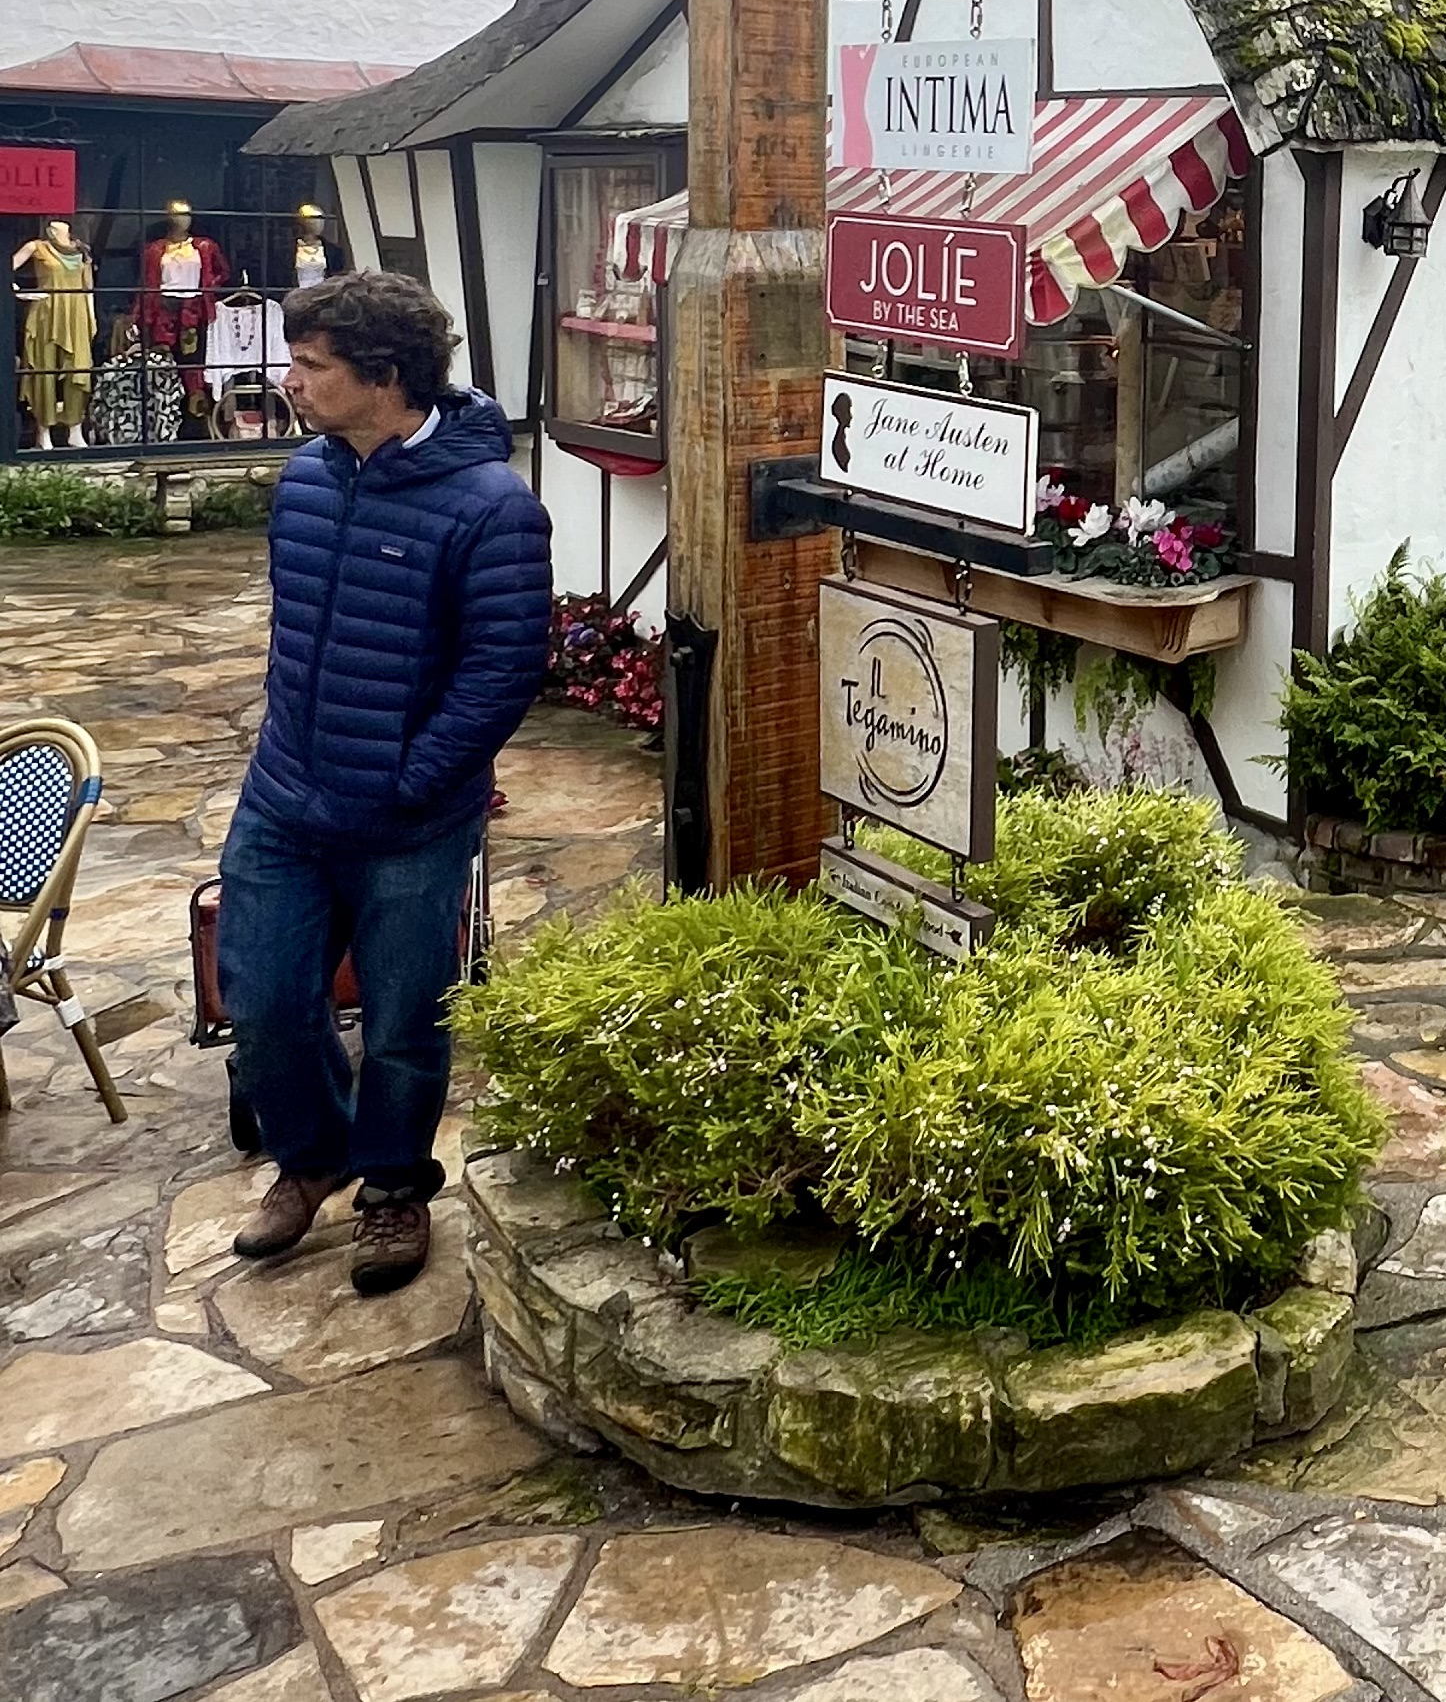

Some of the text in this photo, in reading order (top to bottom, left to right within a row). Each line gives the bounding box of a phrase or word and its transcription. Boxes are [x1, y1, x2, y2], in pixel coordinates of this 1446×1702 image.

[902, 53, 999, 69] EUROPEAN
[884, 73, 1016, 134] INTIMA
[902, 144, 994, 159] LINGERIE
[859, 232, 978, 306] JOLÍE
[872, 299, 960, 332] BY THE SEA
[864, 398, 1010, 456] Jane Austen
[883, 446, 986, 490] at Home
[841, 678, 941, 755] Tegamino
